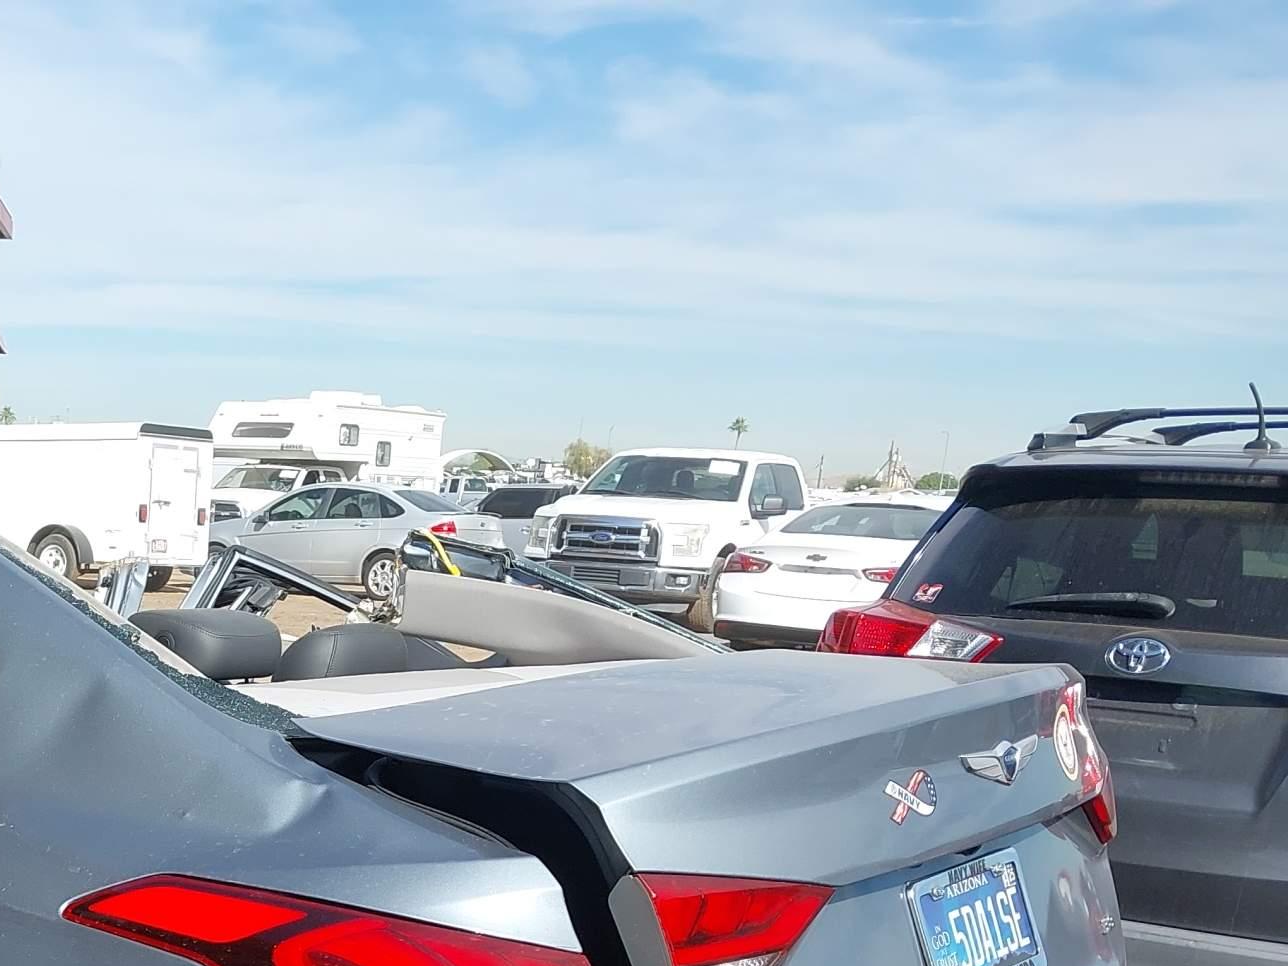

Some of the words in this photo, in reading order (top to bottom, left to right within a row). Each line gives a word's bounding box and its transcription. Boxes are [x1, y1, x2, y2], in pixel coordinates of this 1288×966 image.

[897, 787, 921, 809] NAVY
[947, 866, 968, 884] NAVY
[968, 858, 987, 877] WIFE
[946, 873, 989, 899] ARIZONA
[931, 931, 951, 950] GOD
